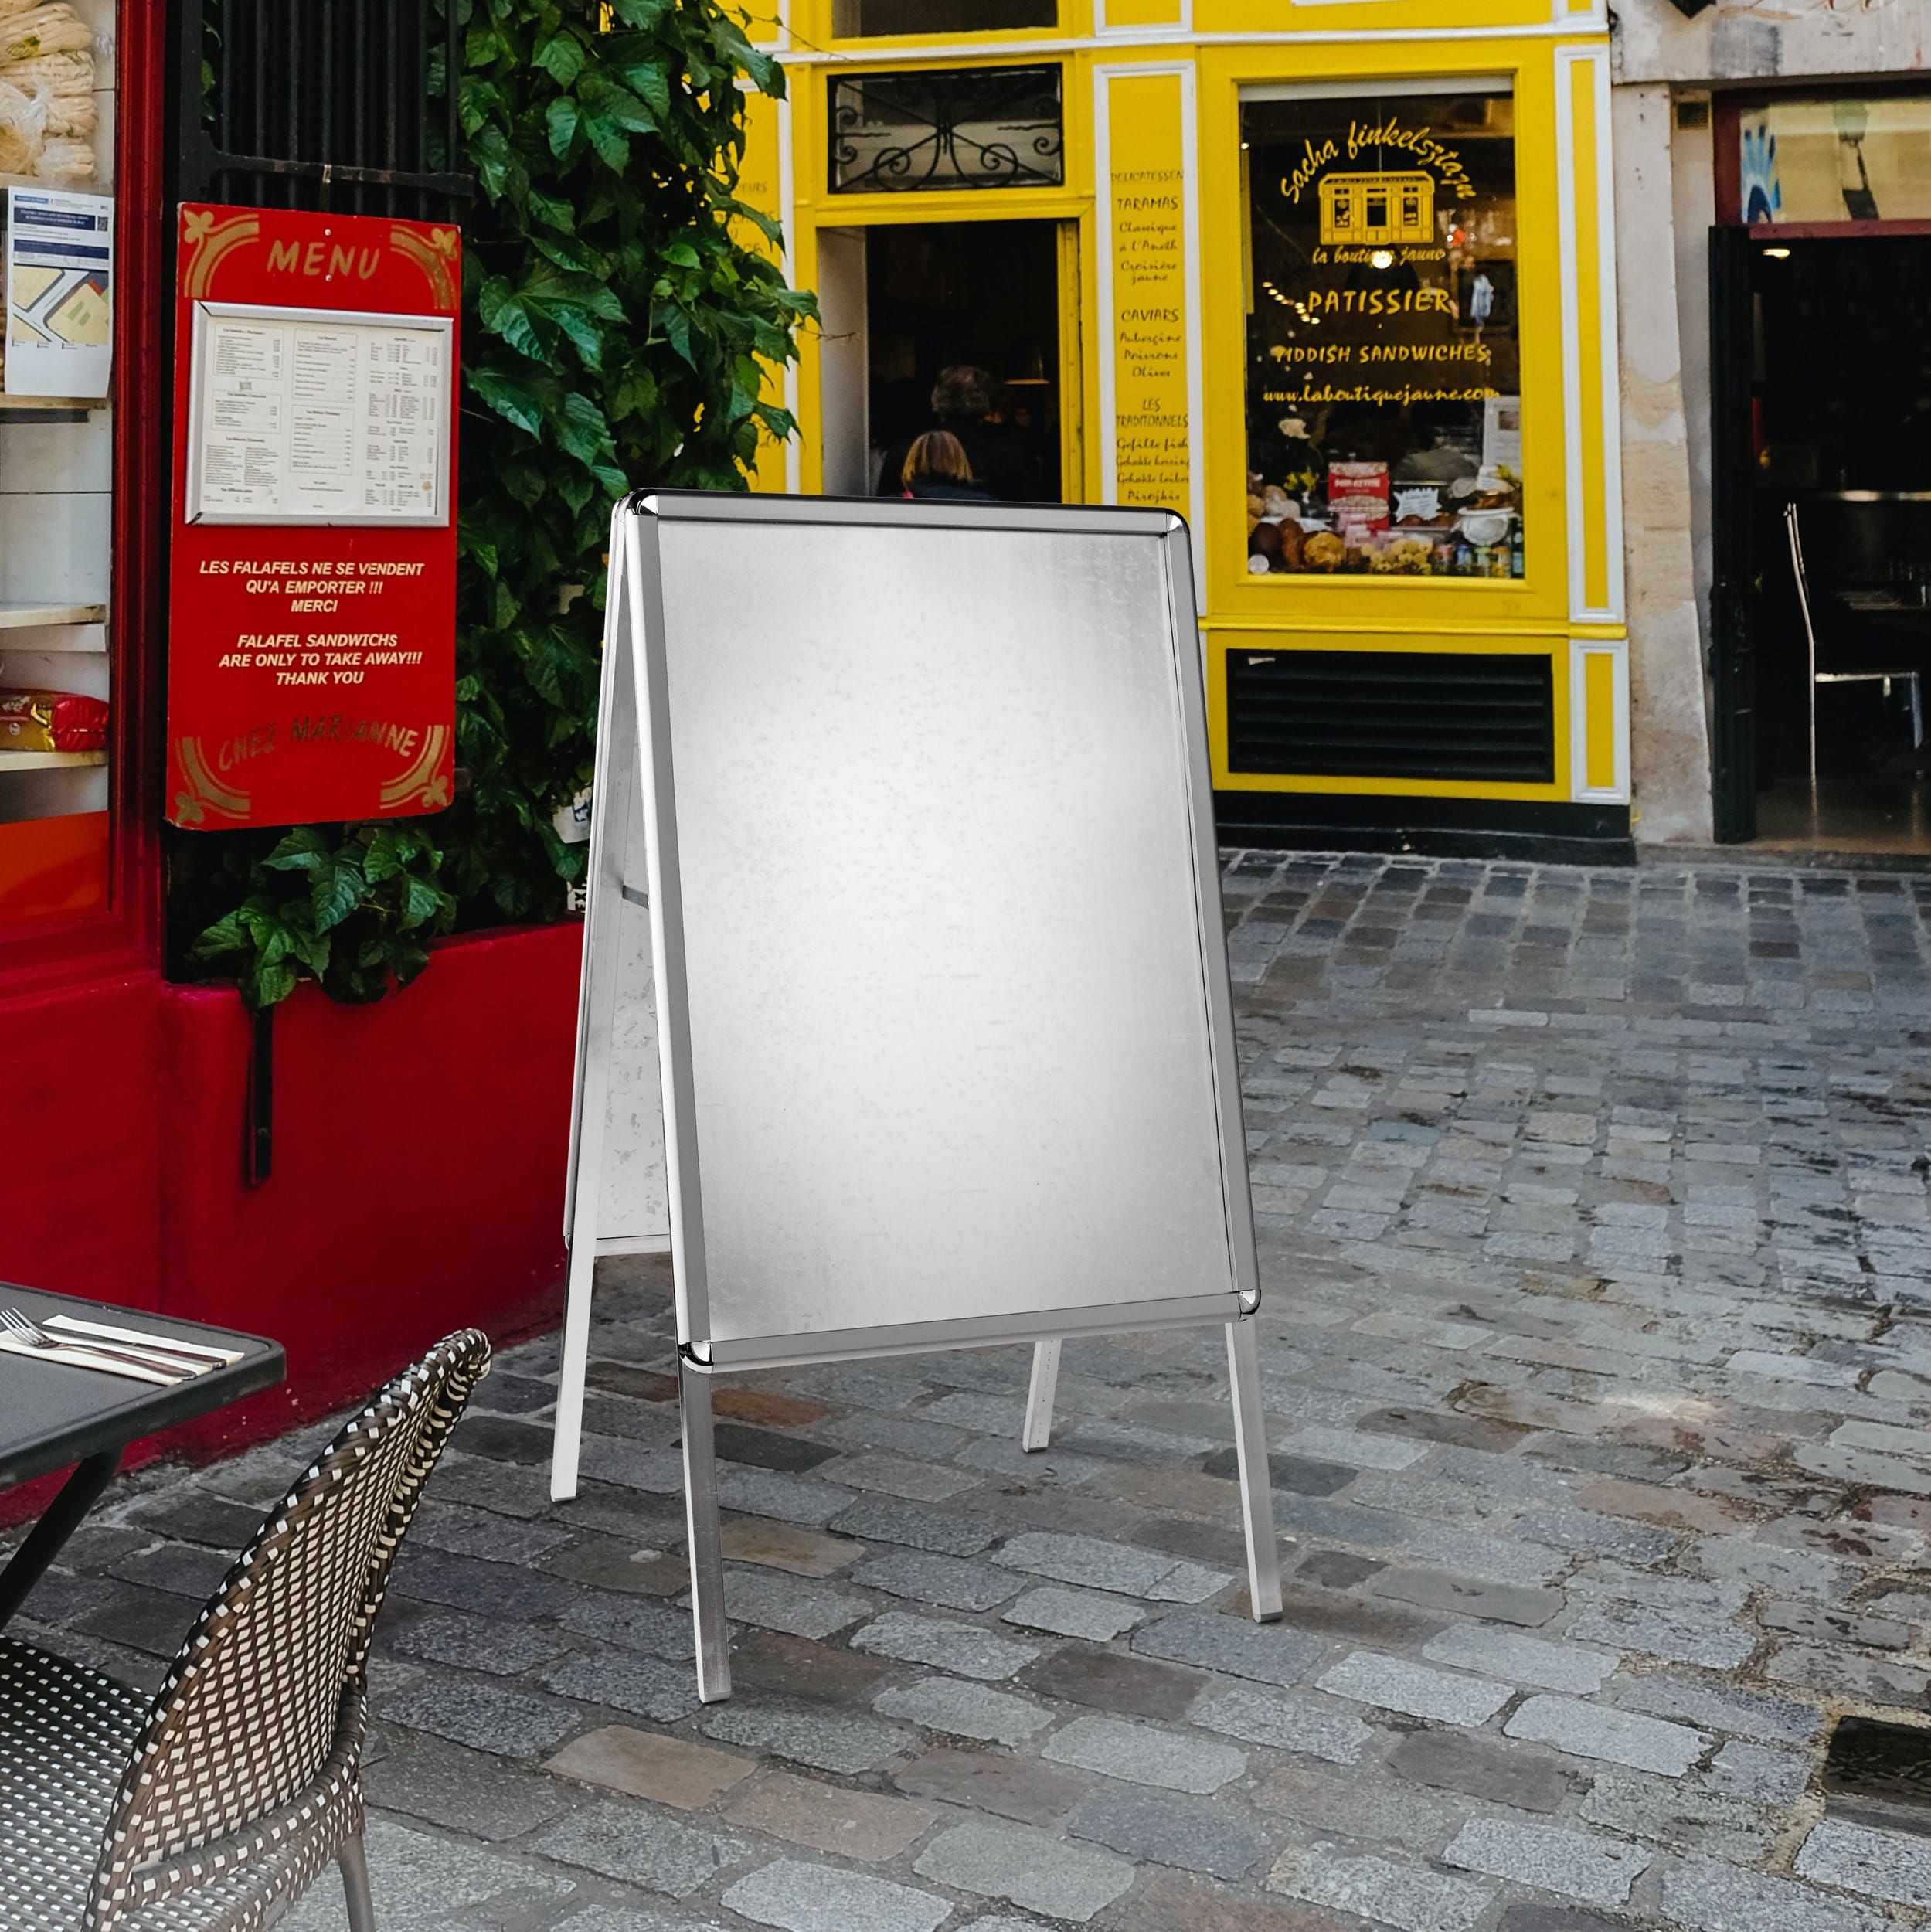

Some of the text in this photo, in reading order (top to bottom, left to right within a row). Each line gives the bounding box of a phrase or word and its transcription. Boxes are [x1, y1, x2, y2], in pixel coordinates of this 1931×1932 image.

[1281, 139, 1339, 204] Sacha
[1117, 196, 1179, 210] TARAMAS
[267, 240, 379, 280] MENU
[1308, 289, 1451, 315] PATISSIER
[1121, 308, 1179, 323] CAVIARS
[1359, 345, 1487, 363] SANDWICHES
[1143, 397, 1161, 412] LES
[200, 561, 424, 576] LES FALAFELS NE SE VENDENT
[246, 580, 383, 594] QU'A EMPORTER !!!
[291, 600, 338, 612] MERCI
[237, 634, 398, 648] FALAFEL SANDWICHS
[219, 651, 423, 667] ARE ONLY TO TAKE AWAY!!!
[277, 671, 364, 685] THANK YOU
[219, 723, 277, 771] CHEZ
